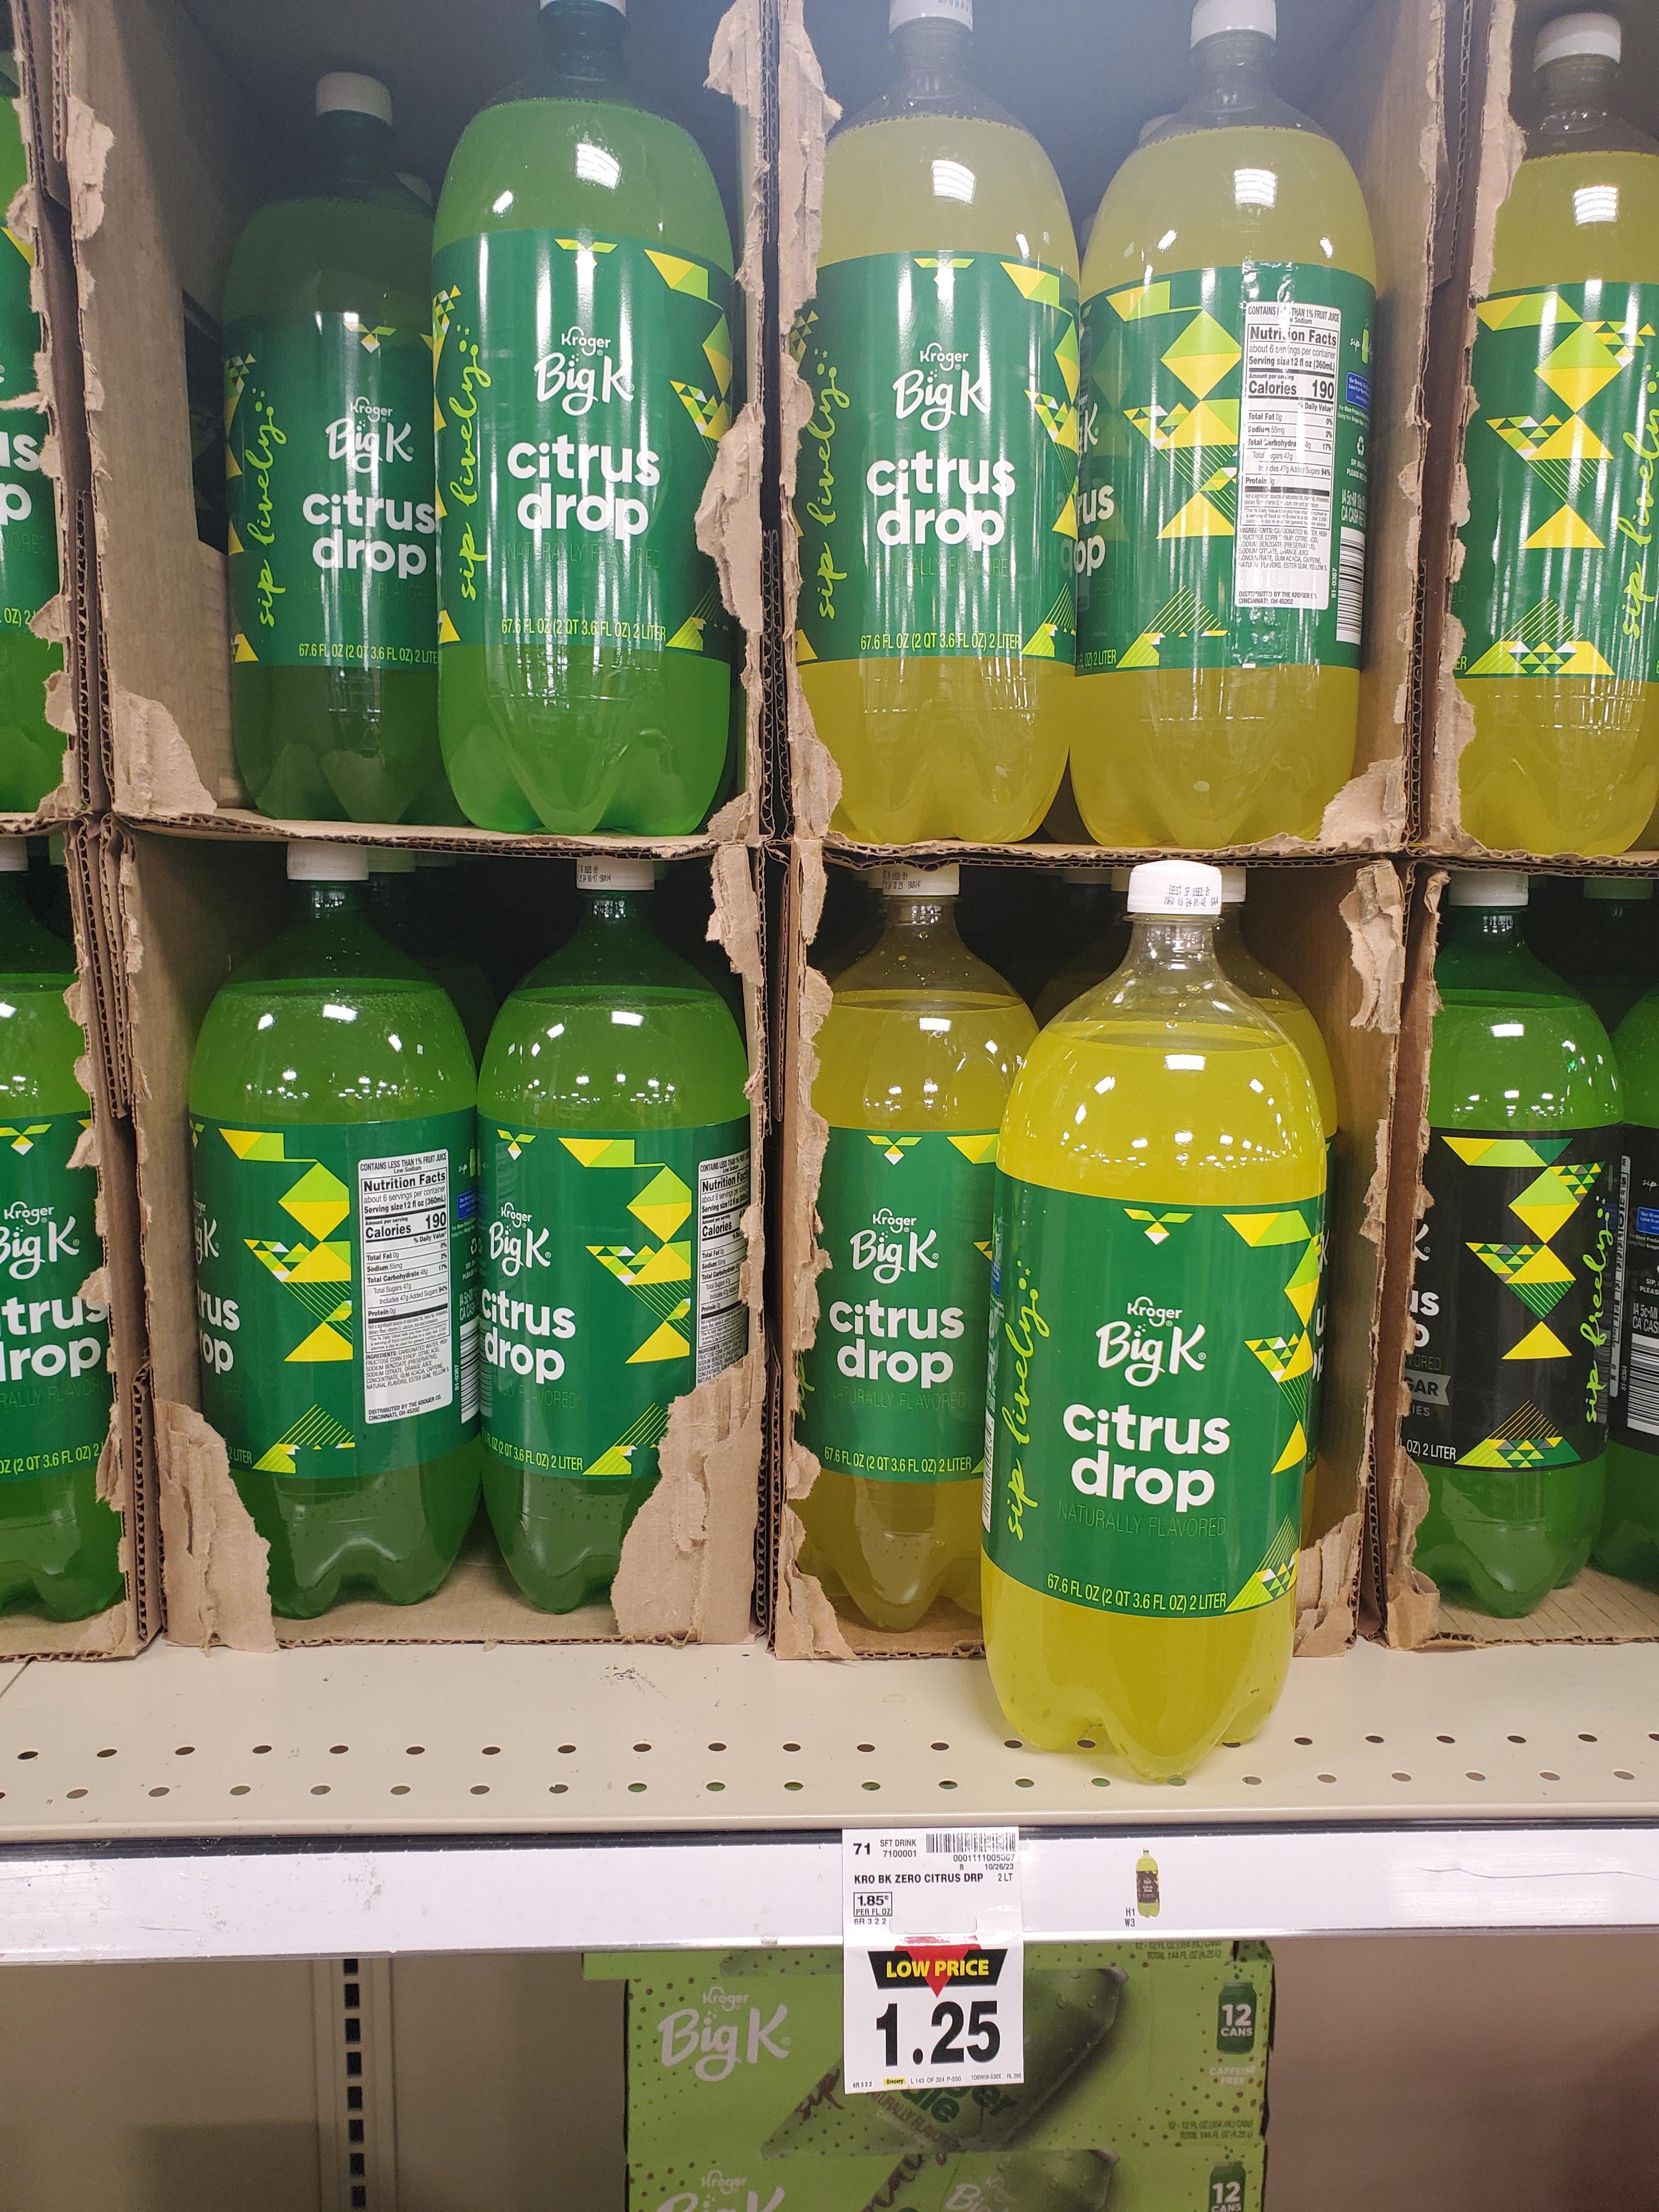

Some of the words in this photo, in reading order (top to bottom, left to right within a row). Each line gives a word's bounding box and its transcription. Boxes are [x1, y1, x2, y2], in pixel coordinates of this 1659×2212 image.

[561, 326, 611, 356] Kroger
[1309, 330, 1336, 346] Facts
[919, 342, 968, 371] Kroger
[1249, 381, 1296, 395] Calories
[1312, 379, 1334, 399] 190
[349, 397, 393, 422] Kroger
[449, 344, 491, 507] lively
[507, 434, 660, 486] citrus
[806, 366, 850, 527] lively
[245, 406, 287, 546] lively
[866, 450, 1015, 497] citrus
[302, 489, 435, 534] citrus
[517, 483, 648, 540] drop
[877, 494, 1005, 551] drop
[312, 528, 427, 579] drop
[461, 522, 488, 601] sip
[258, 559, 286, 627] sip
[819, 541, 848, 620] sip
[1623, 561, 1655, 640] sip
[360, 1162, 386, 1171] CONTAINS
[388, 1160, 400, 1169] LESS
[402, 1158, 414, 1167] THAN
[424, 1155, 435, 1164] FRUIT
[436, 1153, 447, 1162] JUICE
[364, 1178, 415, 1192] Nutrition
[420, 1171, 445, 1185] Facts
[364, 1194, 381, 1204] about
[388, 1192, 413, 1201] servings
[414, 1190, 422, 1199] per
[424, 1186, 445, 1196] container
[4, 1201, 54, 1225] Kroger
[364, 1204, 388, 1214] Serving
[391, 1202, 403, 1211] size
[404, 1201, 411, 1209] 12
[425, 1194, 445, 1207] (360mL)
[500, 1201, 532, 1229] Kroger
[366, 1223, 411, 1239] Calories
[426, 1211, 447, 1229] 190
[702, 1221, 732, 1237] Calories
[872, 1208, 917, 1234] Kroger
[420, 1233, 431, 1242] Daily
[383, 1269, 419, 1282] Carbohydrate
[390, 1263, 402, 1272] 55mg
[1580, 1211, 1613, 1348] freely
[368, 1308, 388, 1317] Protein
[481, 1288, 577, 1339] citrus
[829, 1298, 964, 1339] citrus
[1127, 1296, 1183, 1327] Kroger
[484, 1327, 566, 1385] drop
[837, 1339, 953, 1389] drop
[1001, 1288, 1050, 1446] lively
[1586, 1359, 1606, 1423] sip
[369, 1405, 400, 1415] DISTRIBUTED
[418, 1397, 435, 1406] KROGER
[1063, 1403, 1231, 1454] citrus
[1407, 1438, 1420, 1457] OZ)
[1423, 1442, 1429, 1456] 2
[1431, 1443, 1456, 1460] LITER
[1071, 1450, 1215, 1513] drop
[1007, 1458, 1039, 1542] sip
[1058, 1499, 1142, 1533] NATURALLY
[1149, 1517, 1226, 1537] FLAVORED
[1047, 1573, 1068, 1594] 67.6
[1071, 1580, 1082, 1598] FL
[1085, 1584, 1099, 1602] OZ
[1102, 1588, 1113, 1606] (2
[1115, 1590, 1131, 1607] QT
[1133, 1593, 1150, 1609] 3.6
[1153, 1594, 1166, 1610] FL
[1169, 1595, 1187, 1613] OZ)
[1189, 1595, 1196, 1610] 2
[1199, 1592, 1226, 1610] LITER
[853, 1843, 871, 1855] 71
[854, 1875, 875, 1884] KRO
[878, 1875, 891, 1883] BK
[895, 1874, 921, 1883] ZERO
[924, 1874, 961, 1883] CITRUS
[964, 1873, 983, 1882] DRP
[1125, 1918, 1135, 1927] W3
[1126, 1908, 1135, 1916] H1
[887, 1961, 929, 1977] LOW
[935, 1960, 989, 1976] PRICE
[702, 1986, 749, 2011] Kroger
[1221, 2004, 1252, 2027] 12
[876, 2001, 1000, 2066] 1.25
[1220, 2027, 1252, 2037] CANS
[702, 2170, 747, 2194] Kroger
[1210, 2181, 1241, 2204] 12
